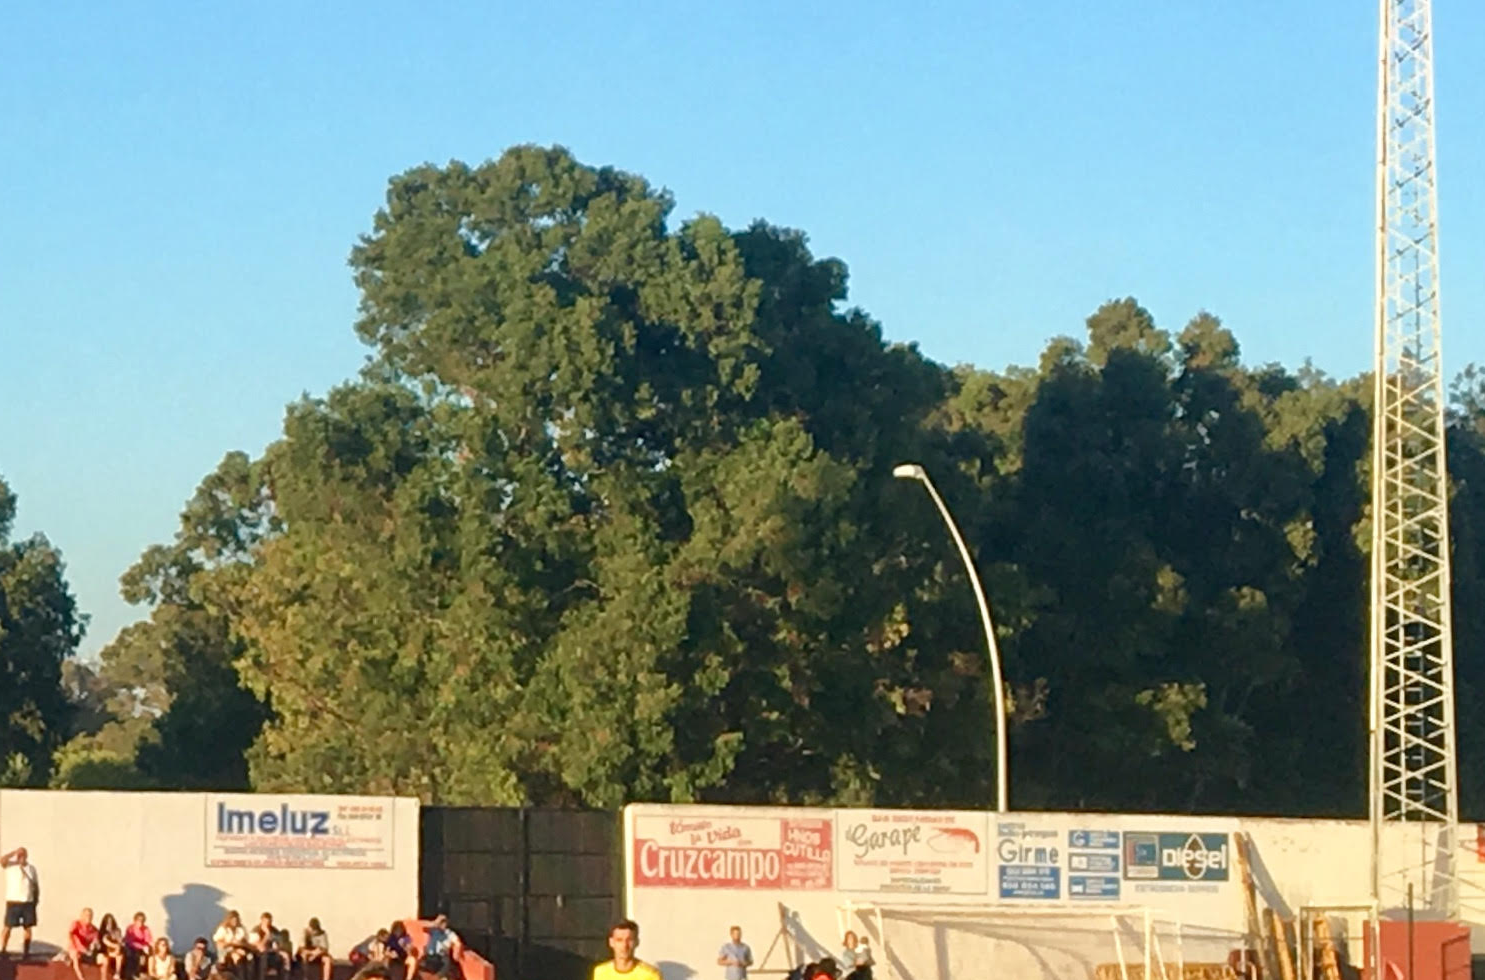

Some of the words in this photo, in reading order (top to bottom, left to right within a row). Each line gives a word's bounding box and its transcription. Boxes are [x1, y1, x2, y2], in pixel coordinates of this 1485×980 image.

[217, 802, 330, 834] Imeluz
[787, 829, 821, 846] HNOS
[640, 841, 779, 887] Cruzcampo
